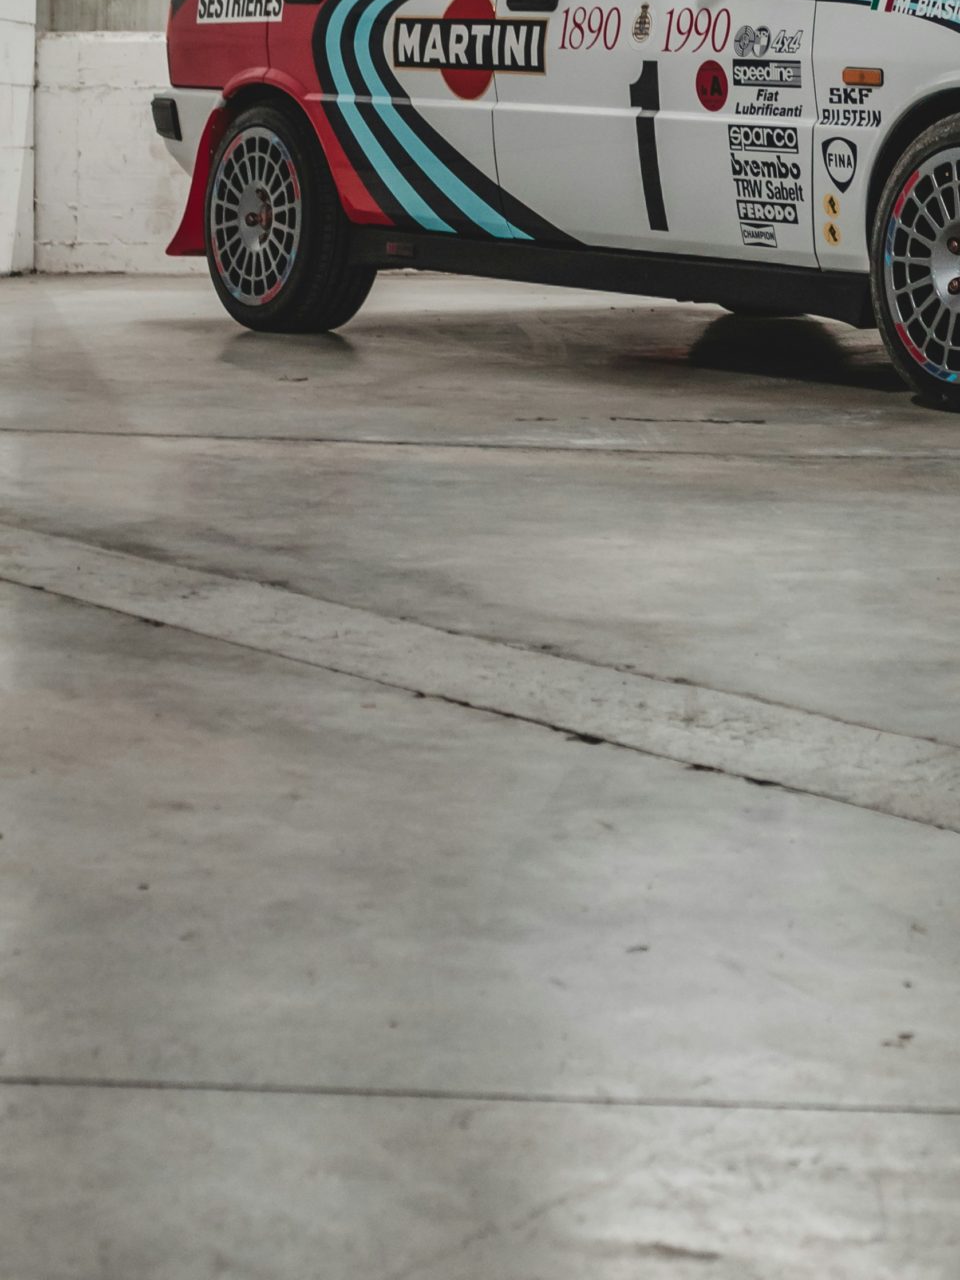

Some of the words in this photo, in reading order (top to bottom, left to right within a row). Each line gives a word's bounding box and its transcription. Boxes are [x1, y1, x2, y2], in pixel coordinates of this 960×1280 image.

[558, 6, 622, 50] 1890
[661, 7, 732, 53] 1990
[397, 23, 542, 67] MARTINI
[771, 29, 803, 54] 4x4
[733, 61, 794, 84] speedline
[756, 89, 779, 102] Fiat
[829, 88, 873, 104] SKF
[735, 102, 803, 118] Lubrificanti
[820, 108, 882, 128] BILSTEIN
[629, 60, 669, 231] 1
[730, 126, 797, 148] sparco
[730, 152, 801, 180] brembo
[827, 153, 853, 169] FINA
[733, 177, 763, 199] TRW
[766, 180, 804, 202] Sabelt
[739, 202, 796, 222] FERODO
[743, 229, 775, 240] CHAMPION
